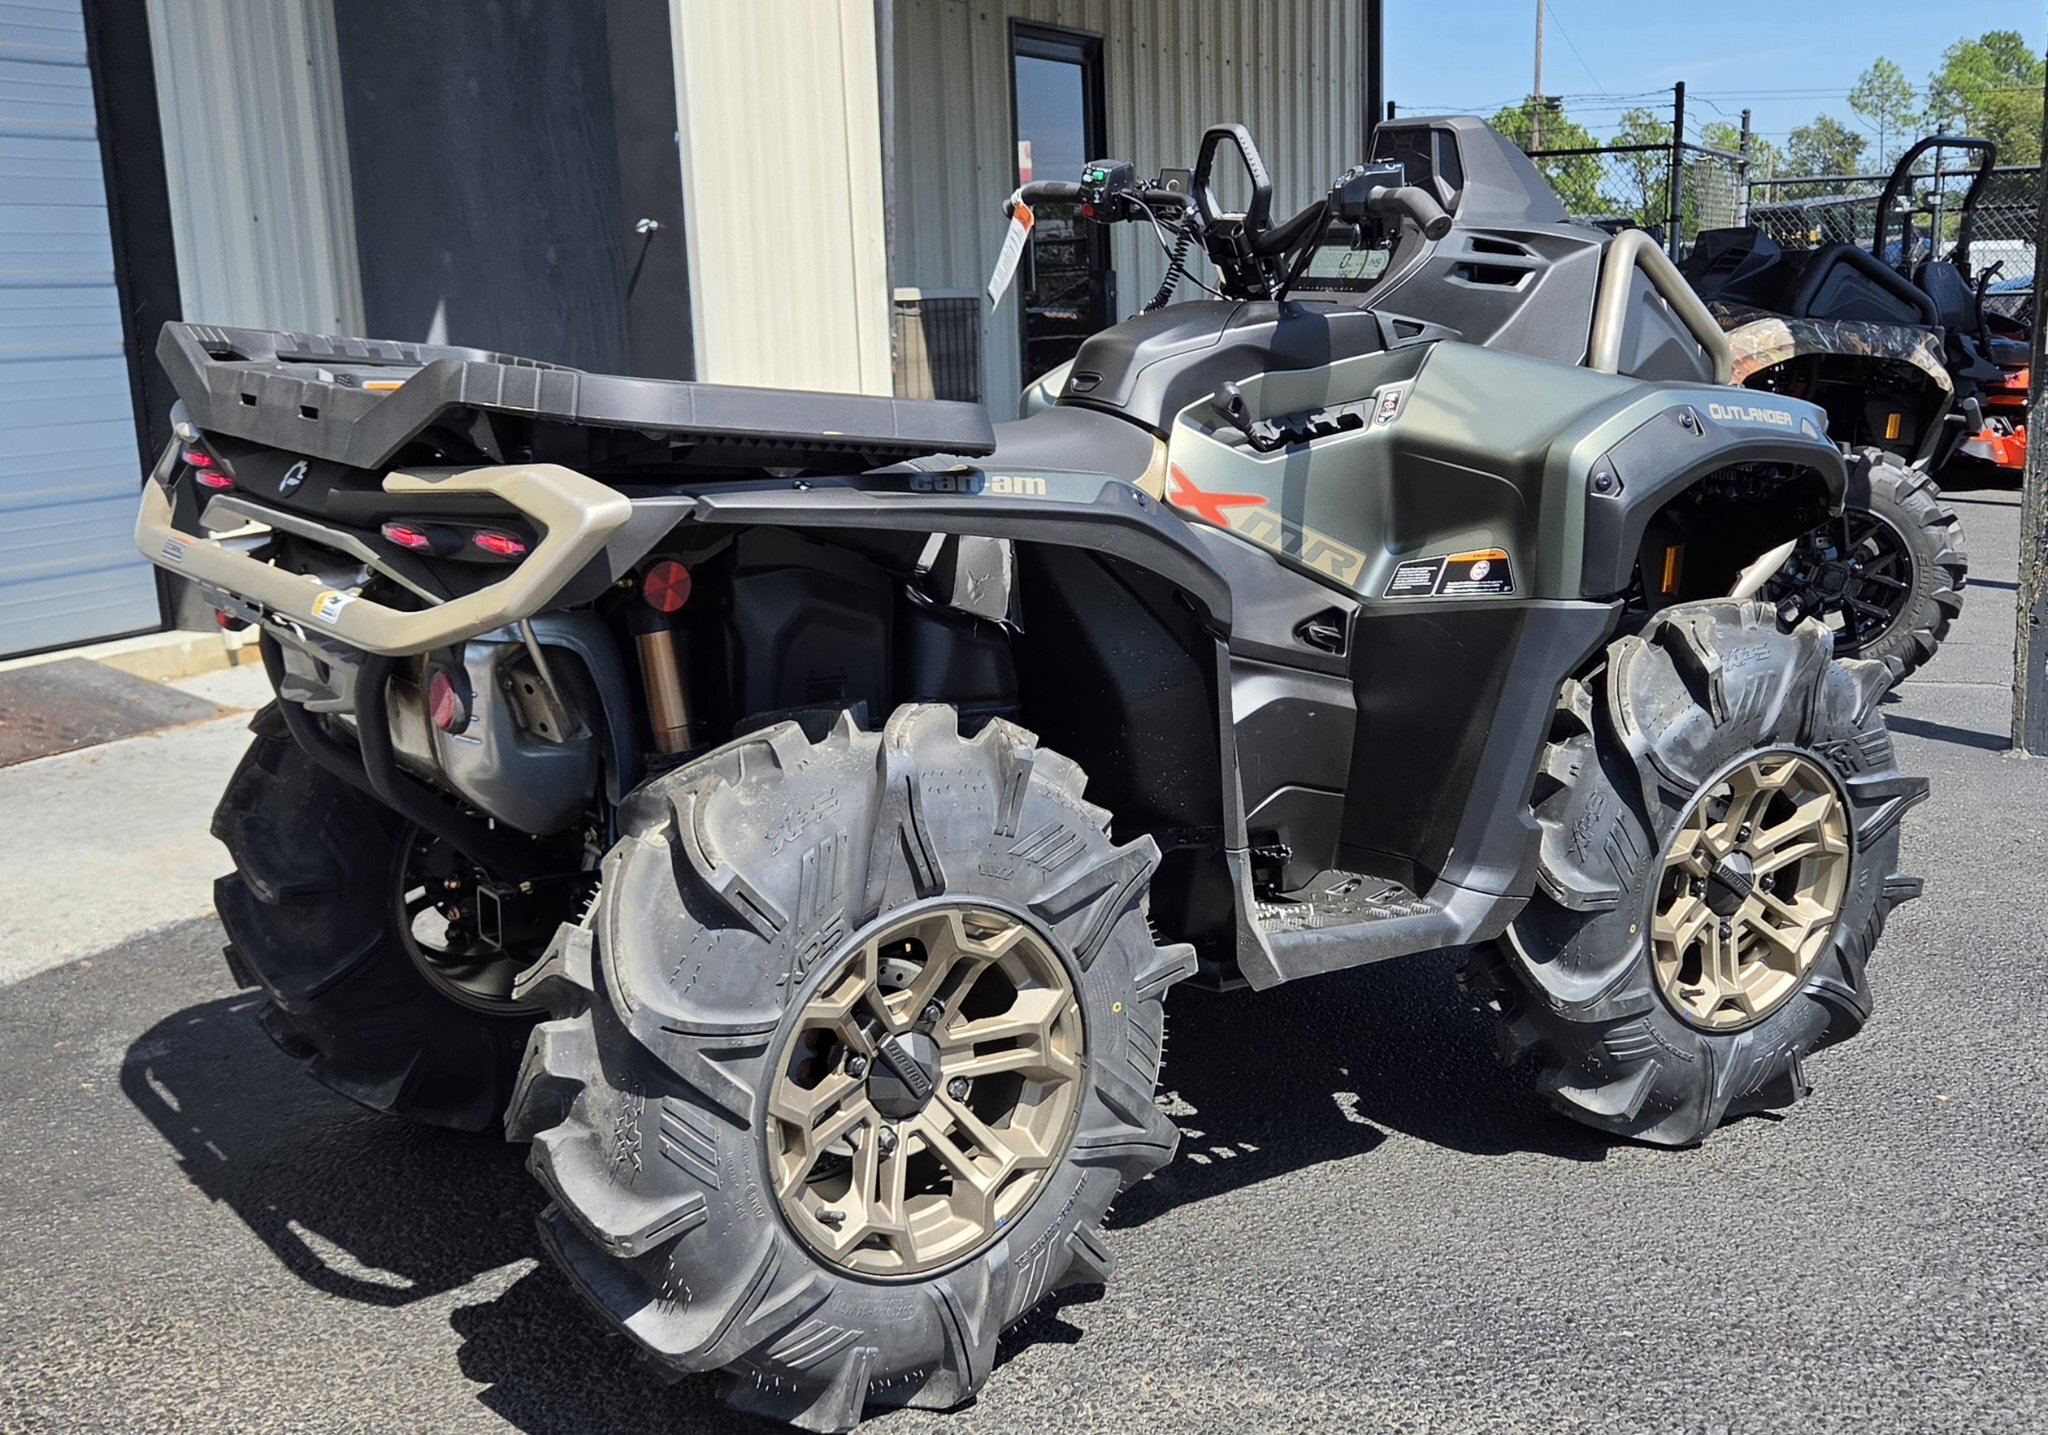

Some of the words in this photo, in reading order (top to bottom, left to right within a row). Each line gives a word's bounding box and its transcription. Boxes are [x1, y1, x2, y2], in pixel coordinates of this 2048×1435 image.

[1708, 402, 1794, 427] OUTLANDER
[909, 475, 1047, 496] can-am
[775, 906, 846, 985] XPS
